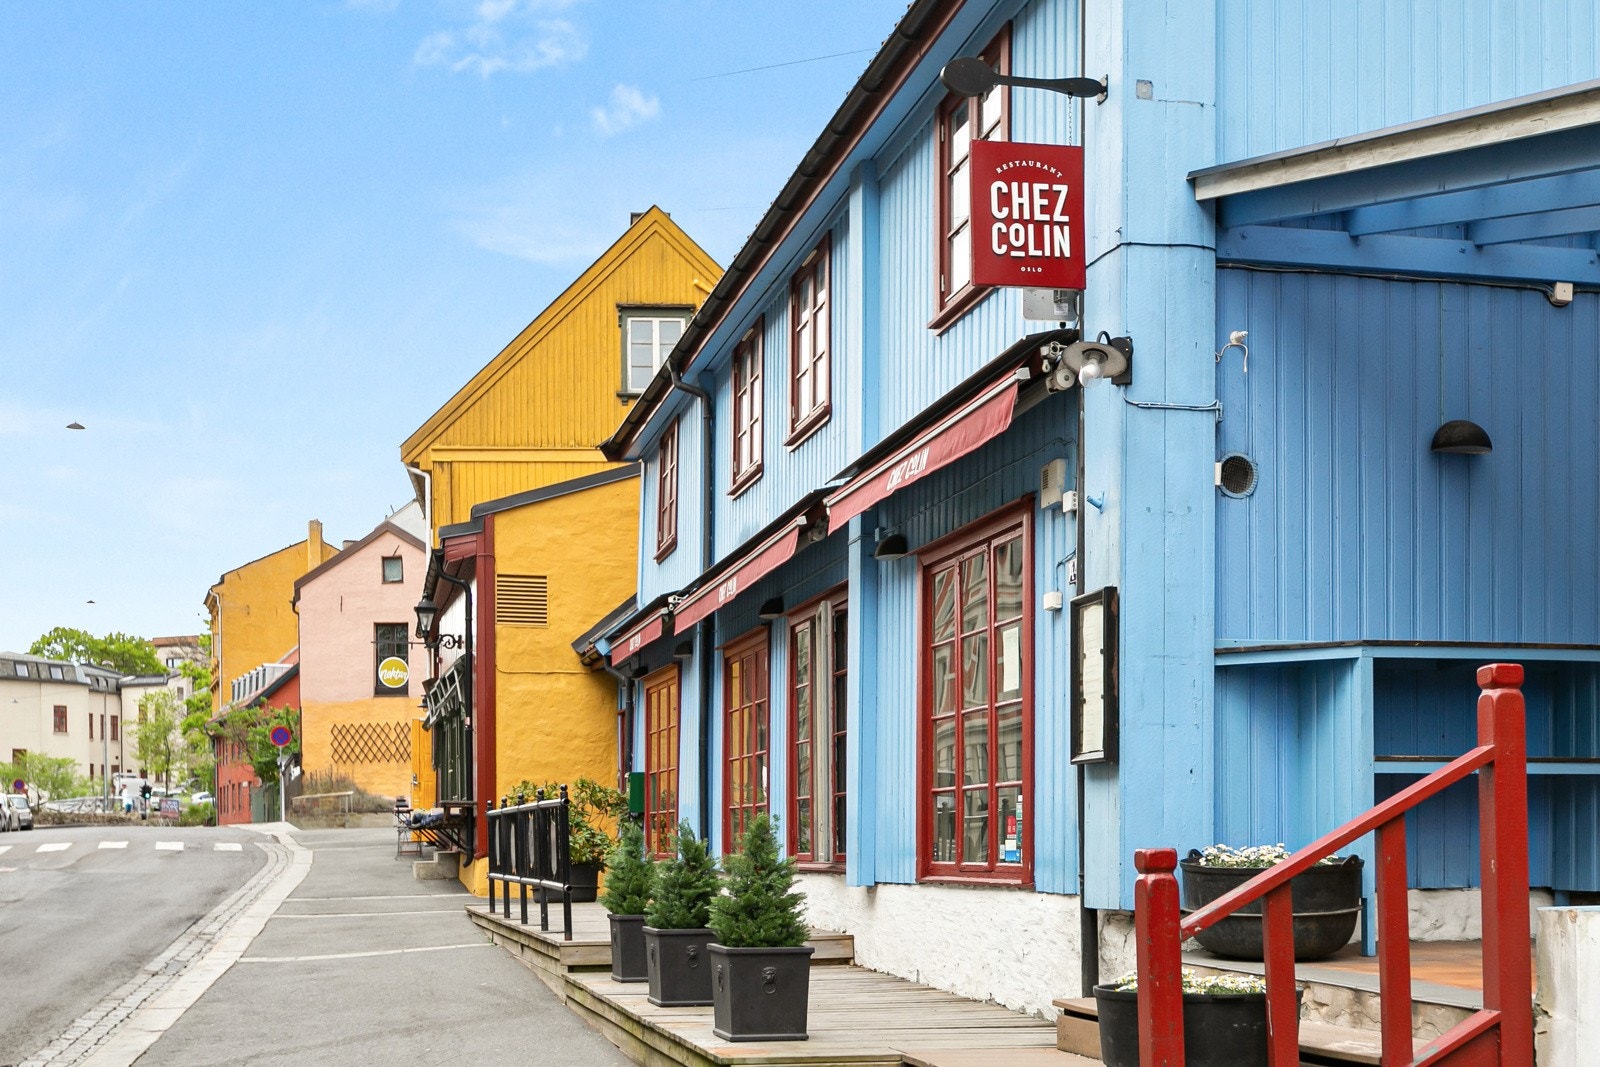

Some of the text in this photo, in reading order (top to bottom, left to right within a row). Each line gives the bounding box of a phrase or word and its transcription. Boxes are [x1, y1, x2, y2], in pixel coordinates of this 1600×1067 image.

[995, 160, 1063, 178] RESTAURANT
[990, 180, 1070, 222] CHEZ
[991, 222, 1071, 258] COLIN
